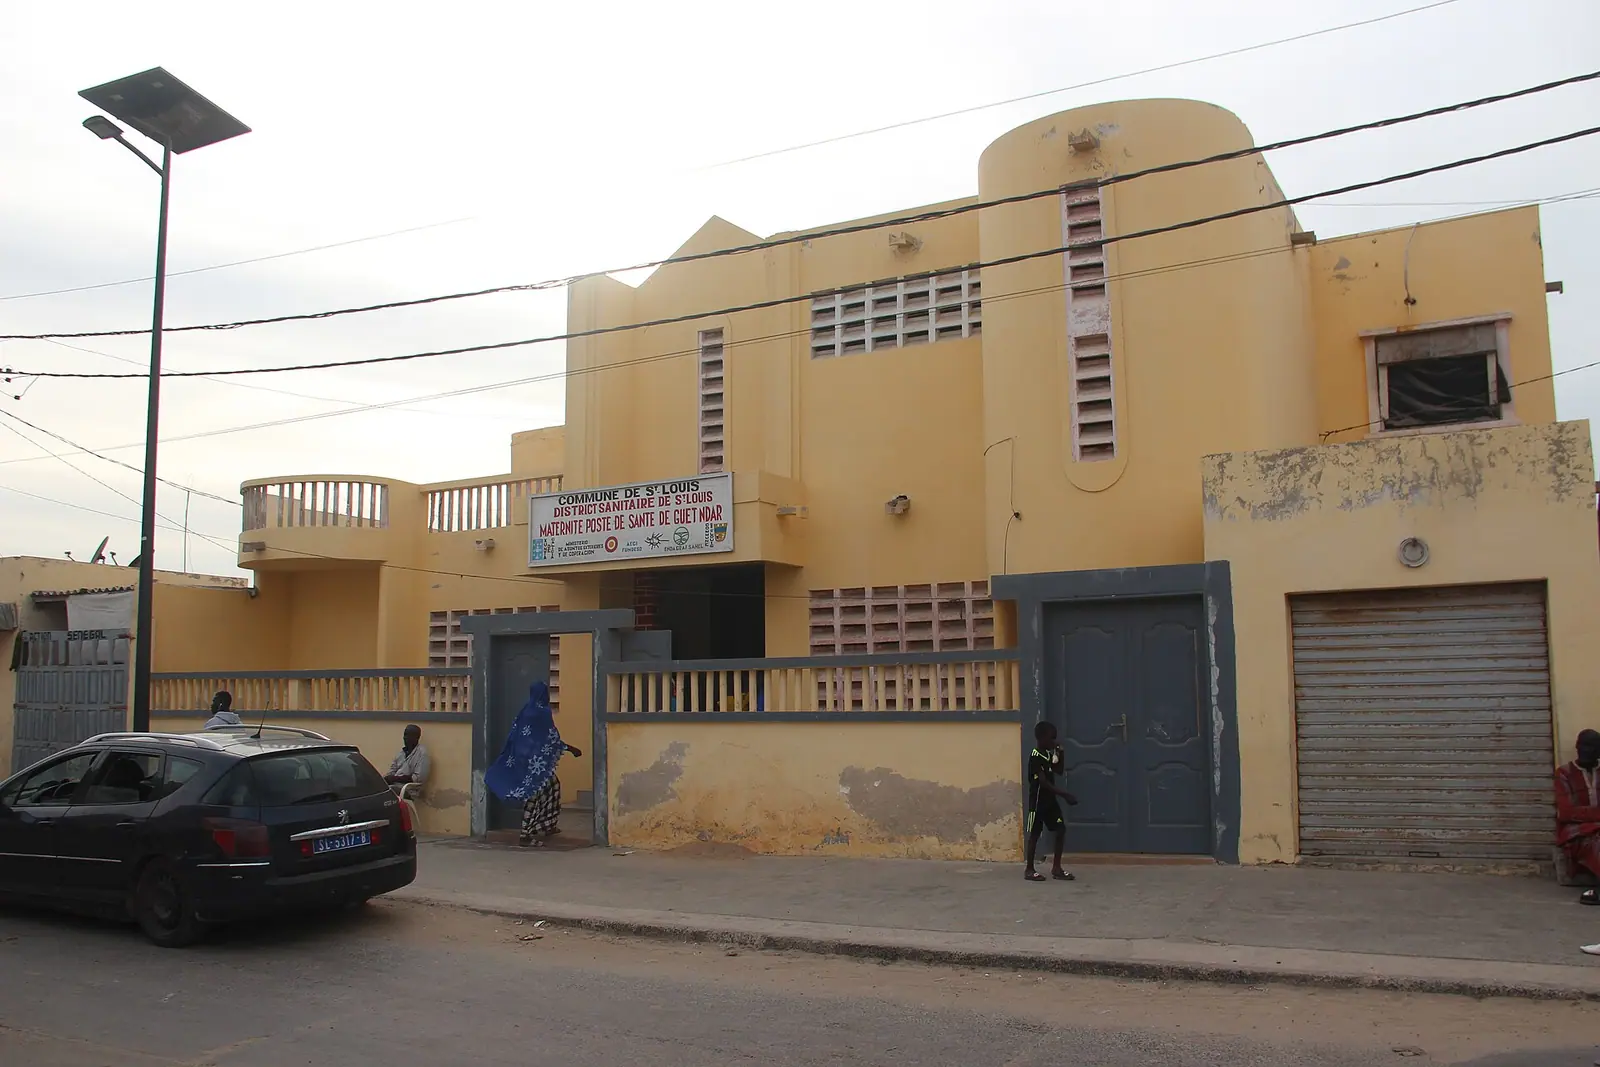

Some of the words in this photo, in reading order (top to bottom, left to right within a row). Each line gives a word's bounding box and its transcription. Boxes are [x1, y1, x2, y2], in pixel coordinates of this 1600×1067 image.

[553, 503, 598, 518] DISTRICT
[598, 497, 655, 514] SANITAIRE
[658, 495, 671, 507] DE
[558, 490, 619, 506] COMMUNE
[625, 487, 640, 499] DE
[539, 519, 583, 538] MATERNITE
[585, 516, 612, 533] POSTE
[614, 514, 625, 530] DE
[628, 511, 655, 529] SANTE
[659, 510, 670, 526] DE
[673, 507, 697, 525] GUET
[699, 504, 723, 523] NDAR
[67, 629, 106, 641] SENEGAL
